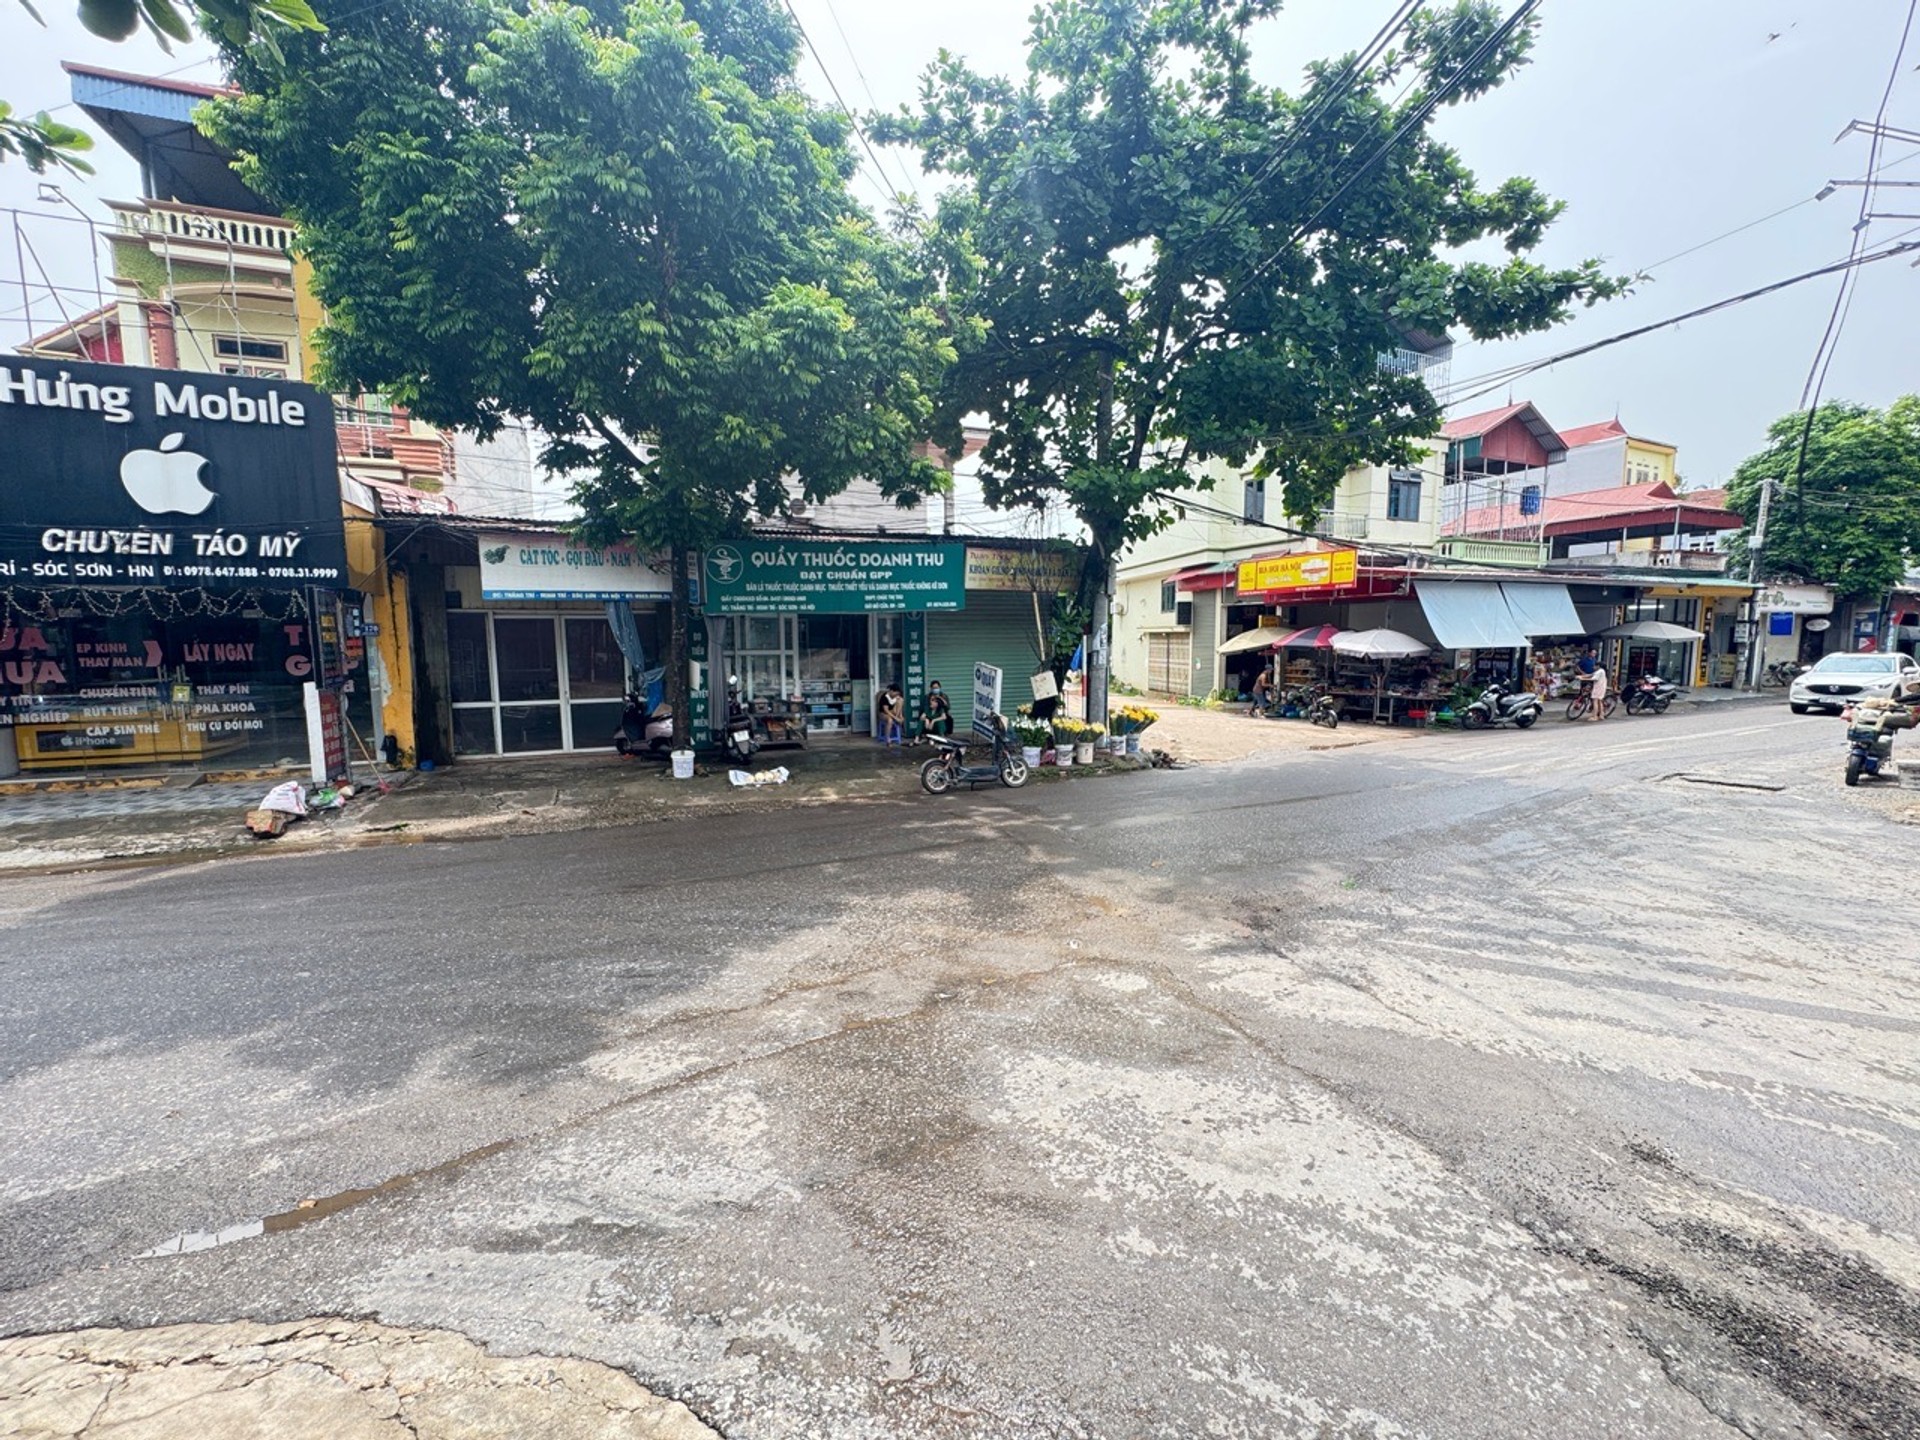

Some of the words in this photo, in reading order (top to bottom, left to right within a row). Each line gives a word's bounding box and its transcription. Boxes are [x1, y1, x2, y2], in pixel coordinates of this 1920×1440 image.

[0, 367, 135, 424] Hưng
[192, 528, 248, 557] TÁO
[259, 531, 302, 558] MỸ
[801, 546, 856, 567] THUỐC
[860, 553, 912, 566] DOANH
[915, 553, 944, 566] THU
[32, 560, 69, 576] SÓC
[75, 562, 113, 577] SƠN
[128, 564, 154, 577] HN
[869, 571, 892, 580] GPP
[214, 642, 255, 662] NGAY
[79, 657, 110, 668] THAY
[197, 684, 226, 696] THAY
[113, 725, 137, 736] SIM
[74, 736, 116, 746] iPhone
